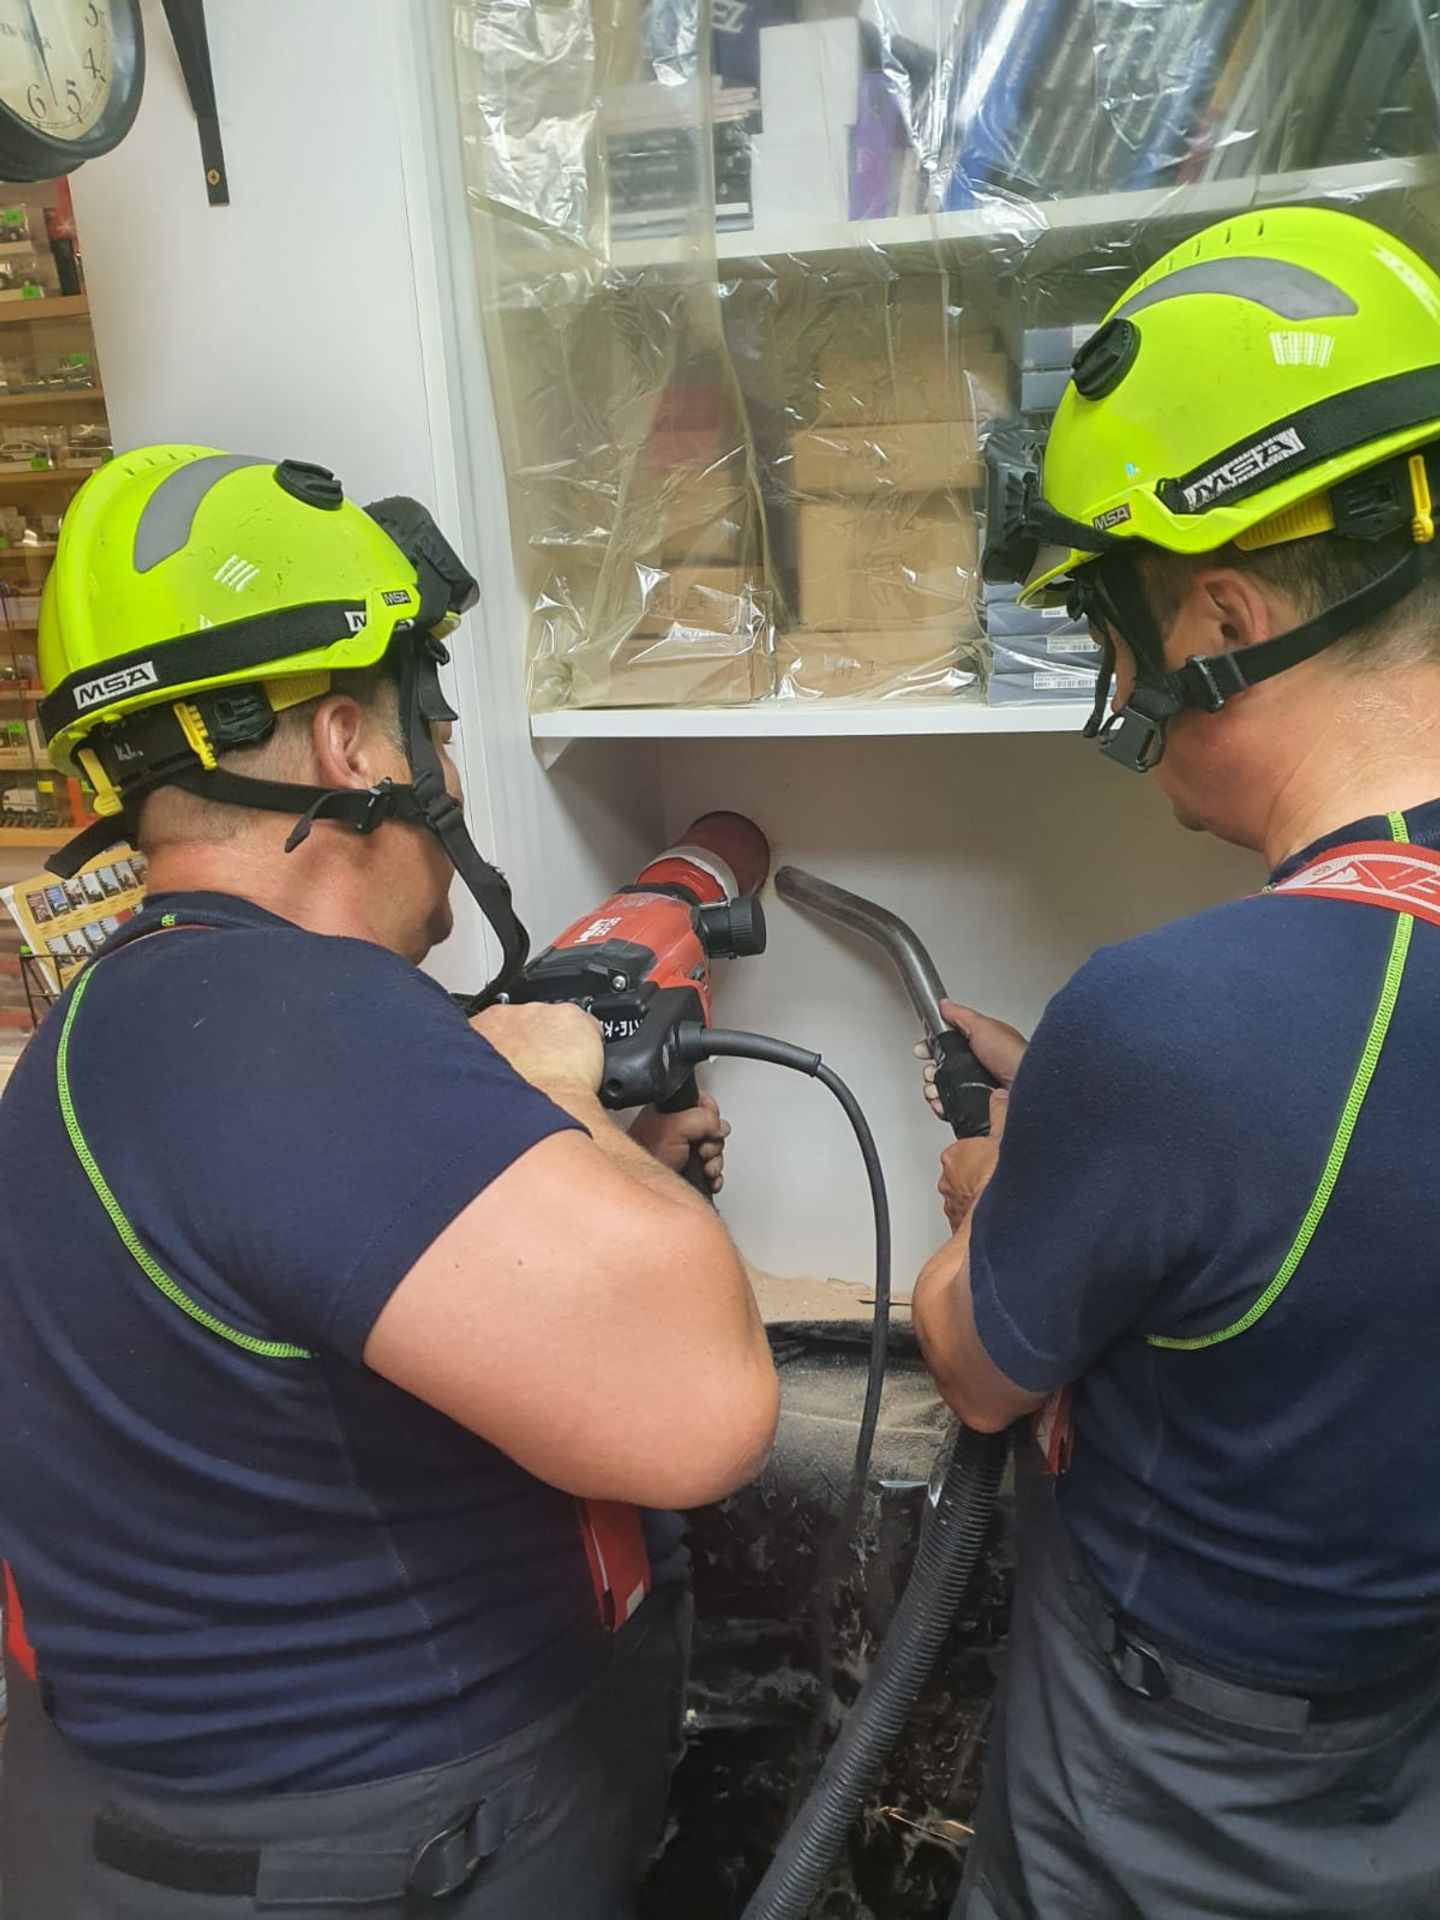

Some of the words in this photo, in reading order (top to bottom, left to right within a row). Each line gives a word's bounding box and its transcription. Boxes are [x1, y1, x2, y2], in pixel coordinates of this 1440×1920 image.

[83, 47, 101, 79] 4
[27, 83, 47, 119] 6
[65, 79, 82, 117] 5
[1194, 440, 1294, 508] MSA
[1094, 506, 1129, 530] MSA
[384, 591, 409, 605] MSA
[80, 668, 150, 704] MSA
